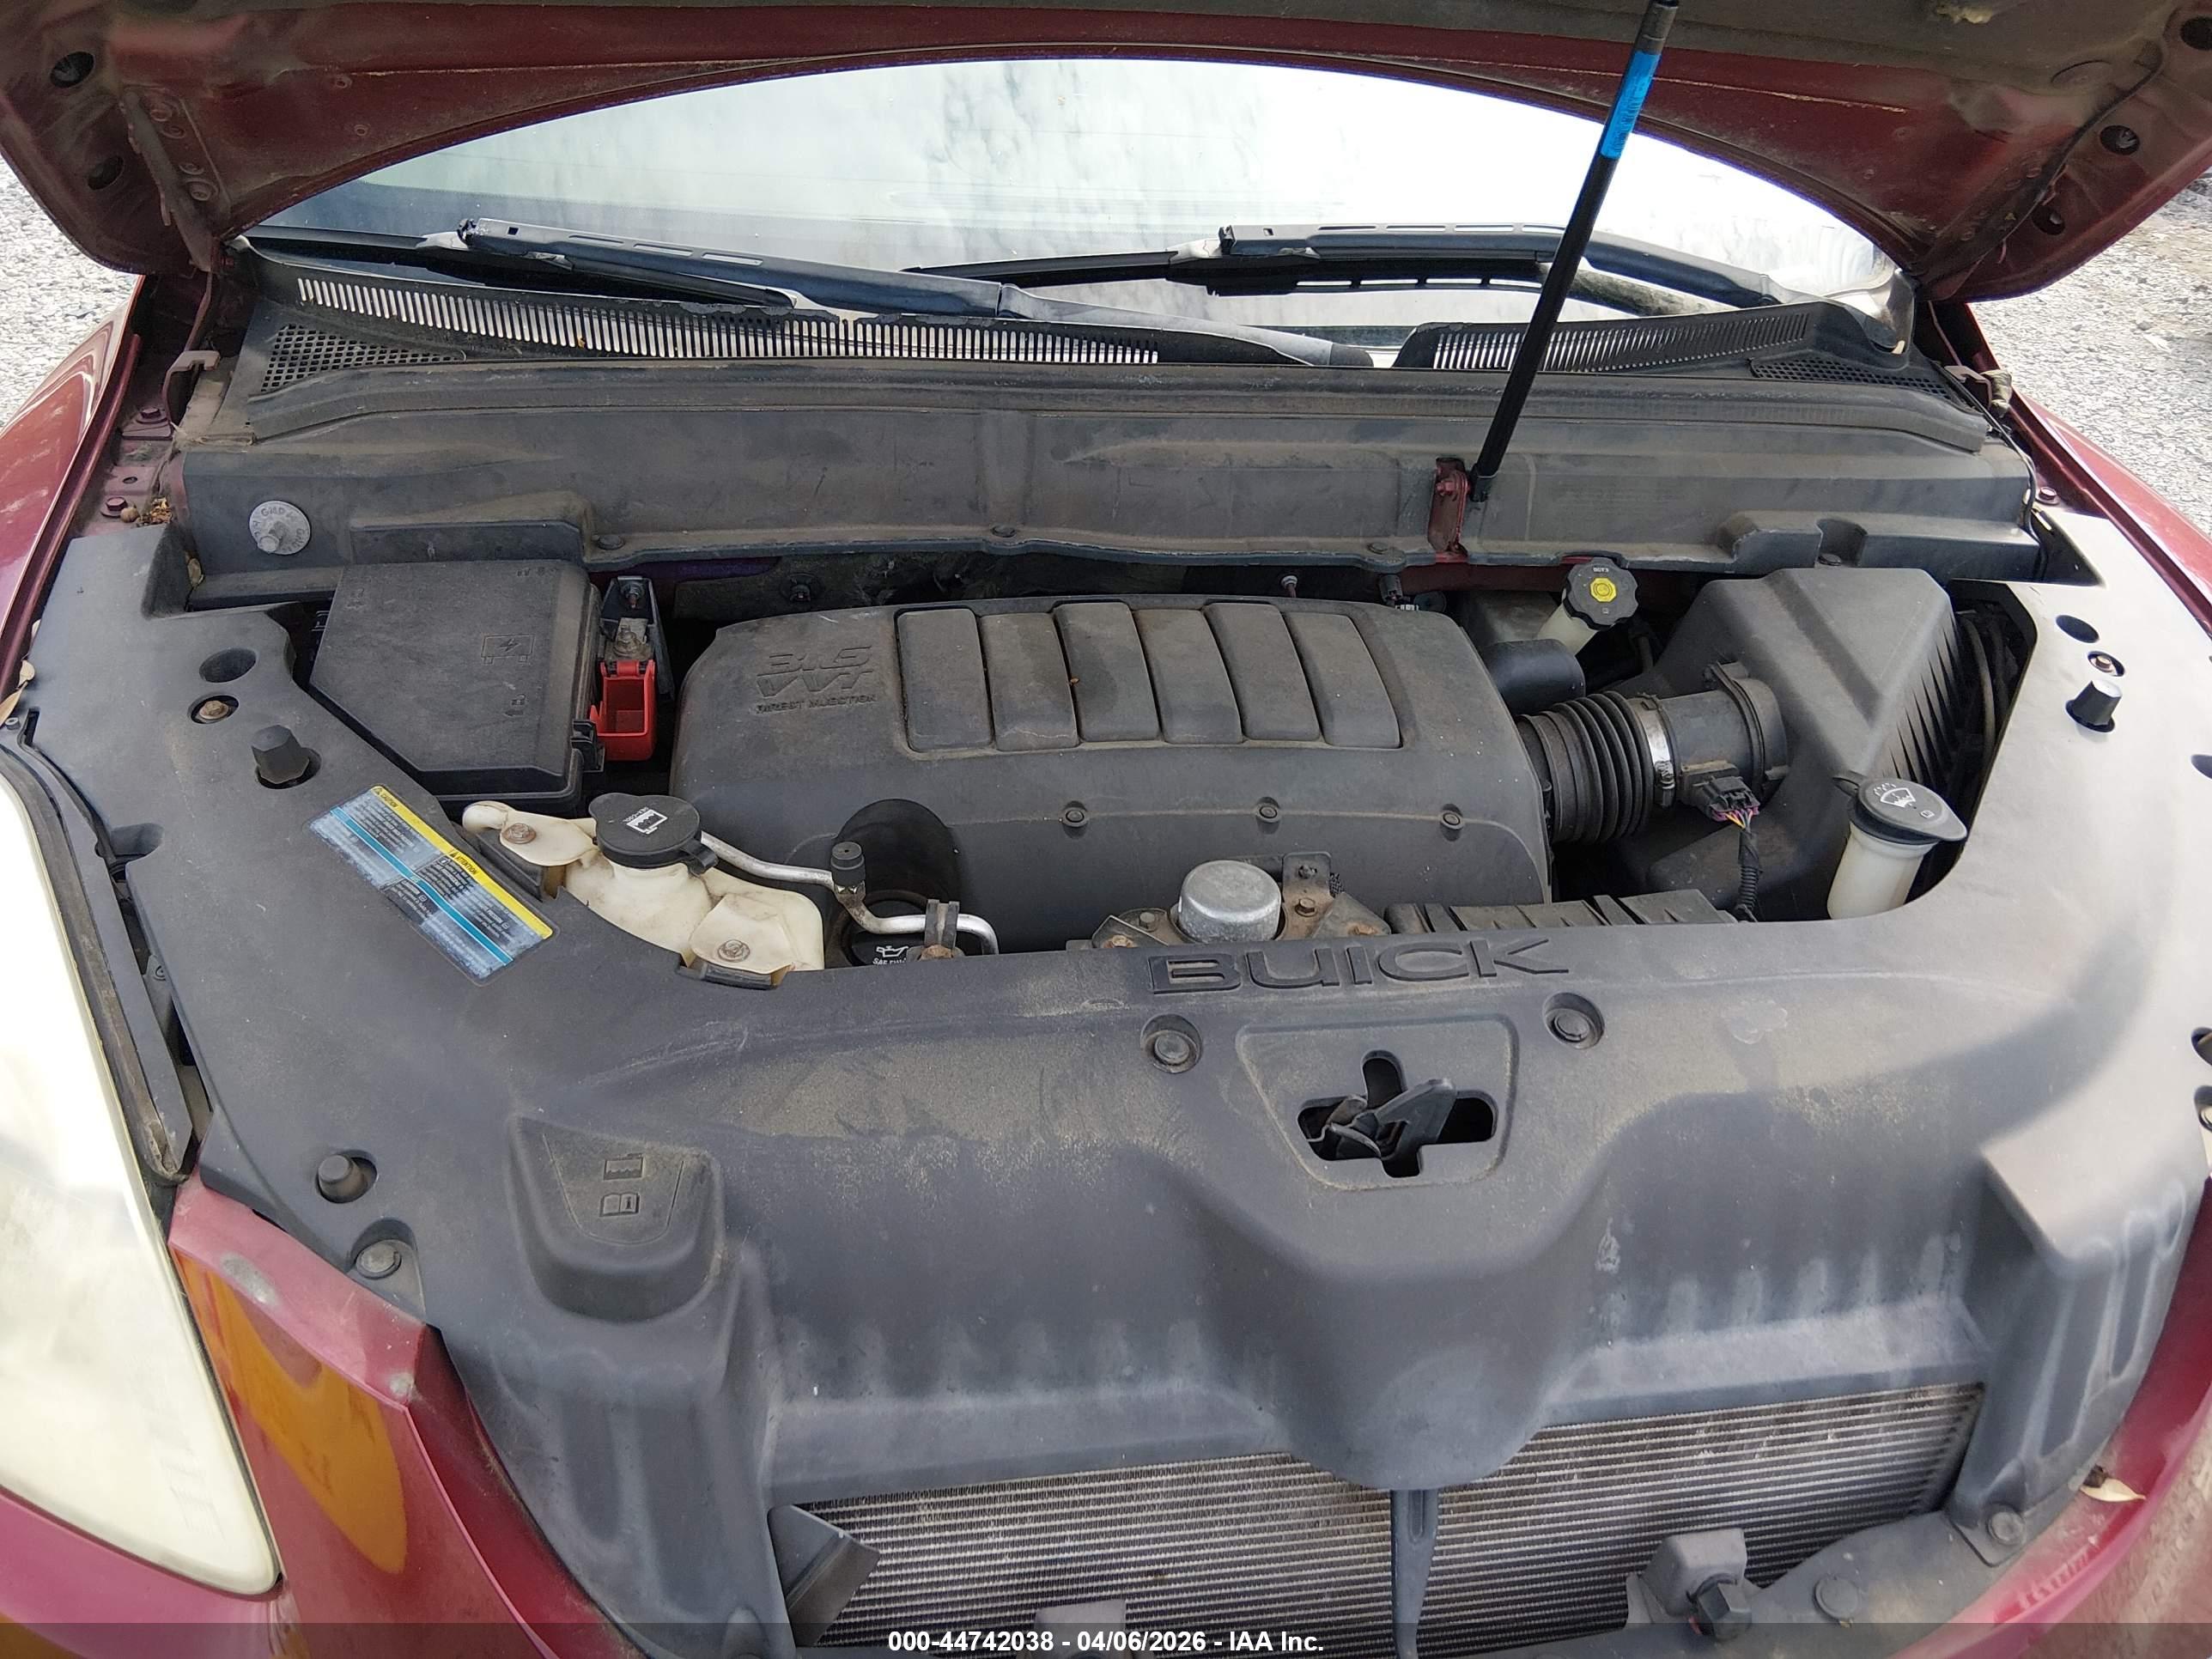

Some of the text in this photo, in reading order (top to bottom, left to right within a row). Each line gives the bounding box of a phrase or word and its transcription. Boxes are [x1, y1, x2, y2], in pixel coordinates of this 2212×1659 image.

[756, 670, 873, 698] VVT
[757, 694, 878, 714] DIRECT INJECTION
[454, 854, 479, 876] ATTENTION
[1147, 937, 1570, 996] BUICK
